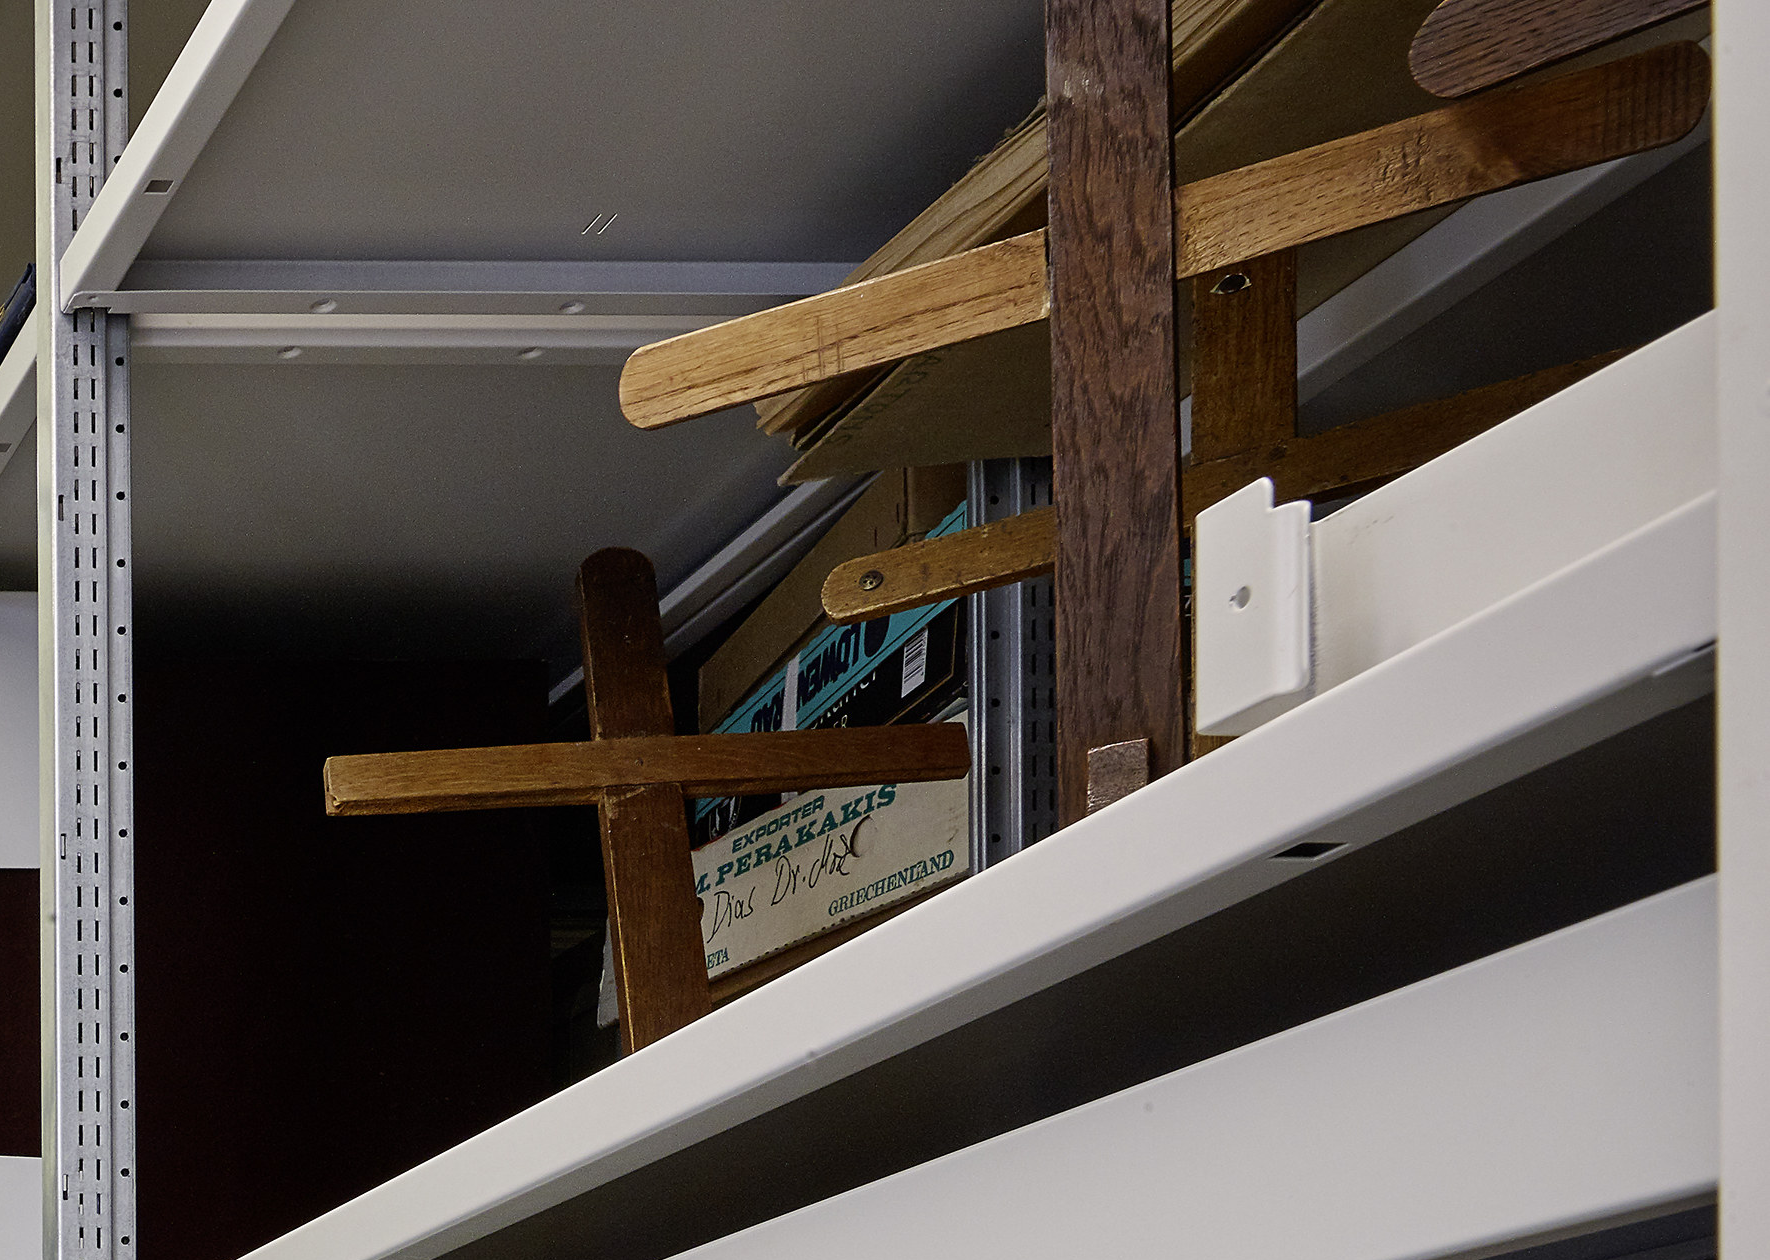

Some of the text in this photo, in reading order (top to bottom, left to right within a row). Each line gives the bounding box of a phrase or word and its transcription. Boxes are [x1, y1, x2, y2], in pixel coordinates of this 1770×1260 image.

[715, 784, 897, 887] PERAKAKIS
[732, 795, 825, 854] EXPORTER
[828, 849, 955, 917] GRIECHENLAND
